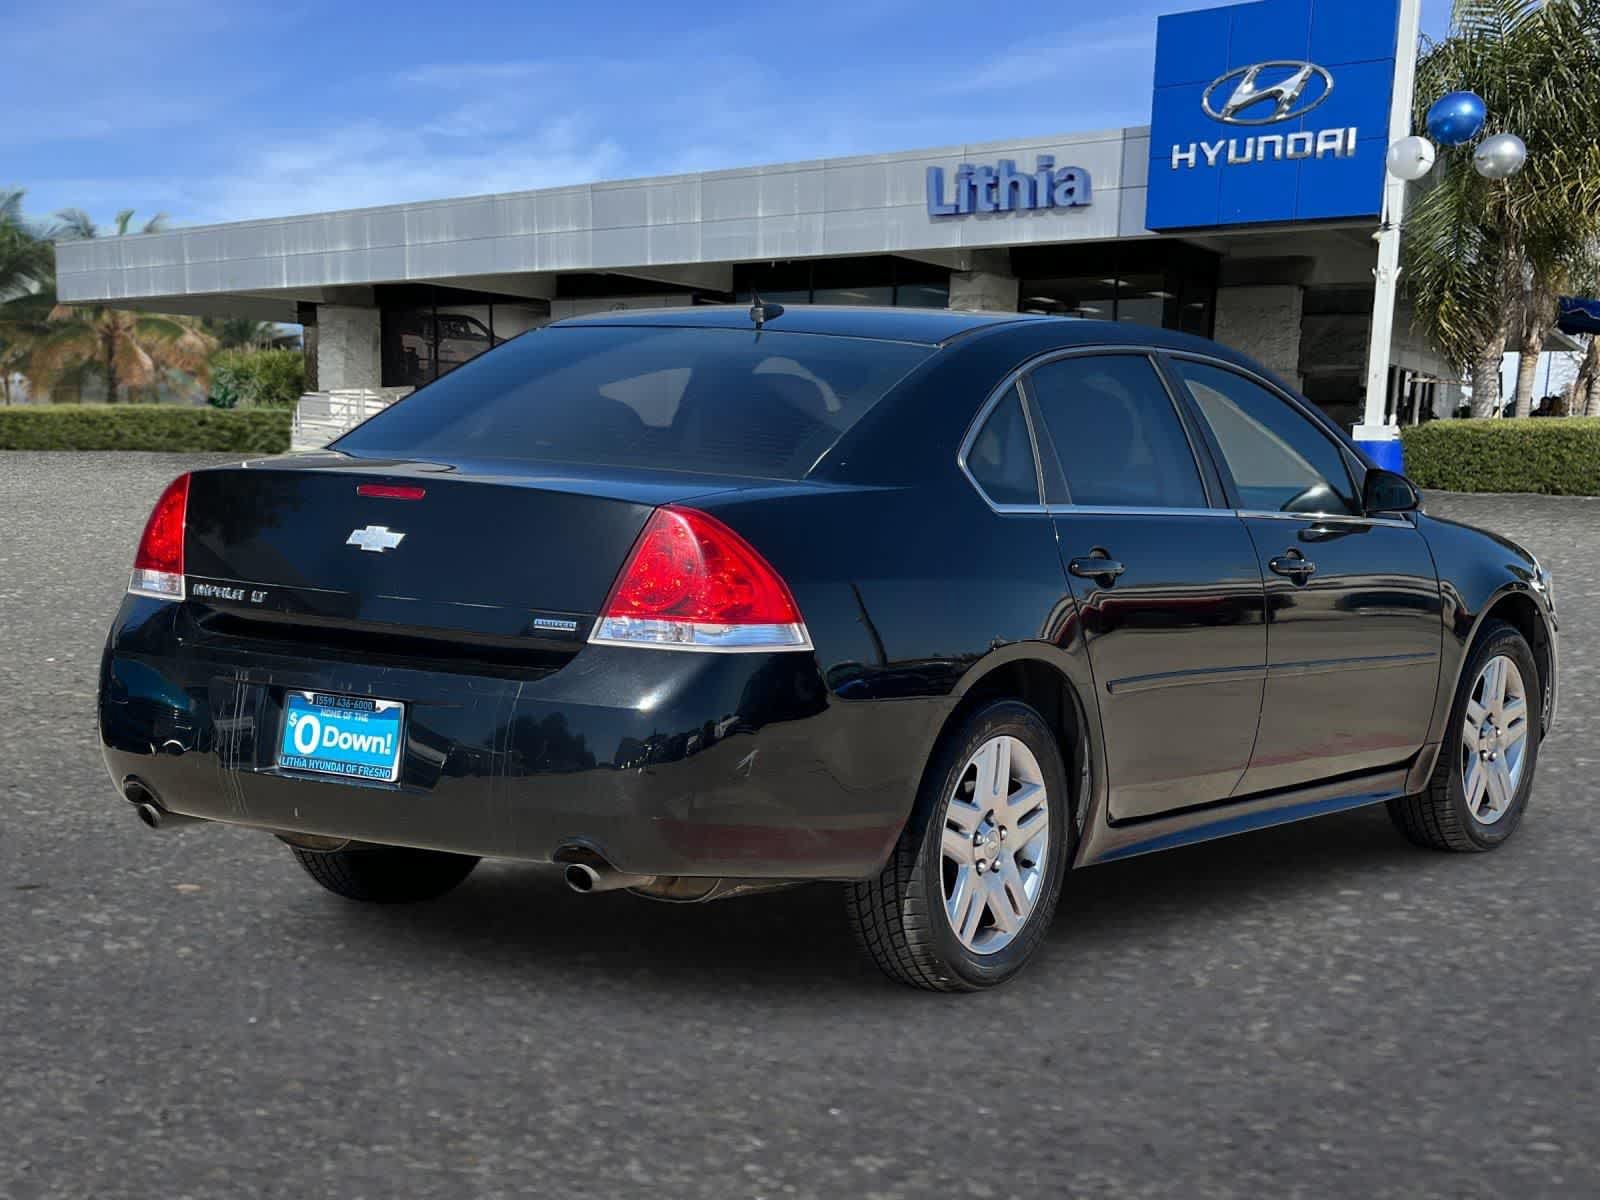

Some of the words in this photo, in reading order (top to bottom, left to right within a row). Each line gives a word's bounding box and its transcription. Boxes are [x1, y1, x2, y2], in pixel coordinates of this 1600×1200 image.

[1171, 127, 1357, 169] HYUNDAI
[926, 154, 1093, 217] Lithia
[193, 583, 245, 600] IMPALA
[251, 590, 268, 603] LT
[316, 695, 335, 706] (559)
[322, 725, 393, 755] Down!
[281, 756, 307, 769] LITHIA
[308, 759, 344, 773] HYUNDAI
[346, 764, 357, 774] OF
[358, 766, 391, 778] FRESNO
